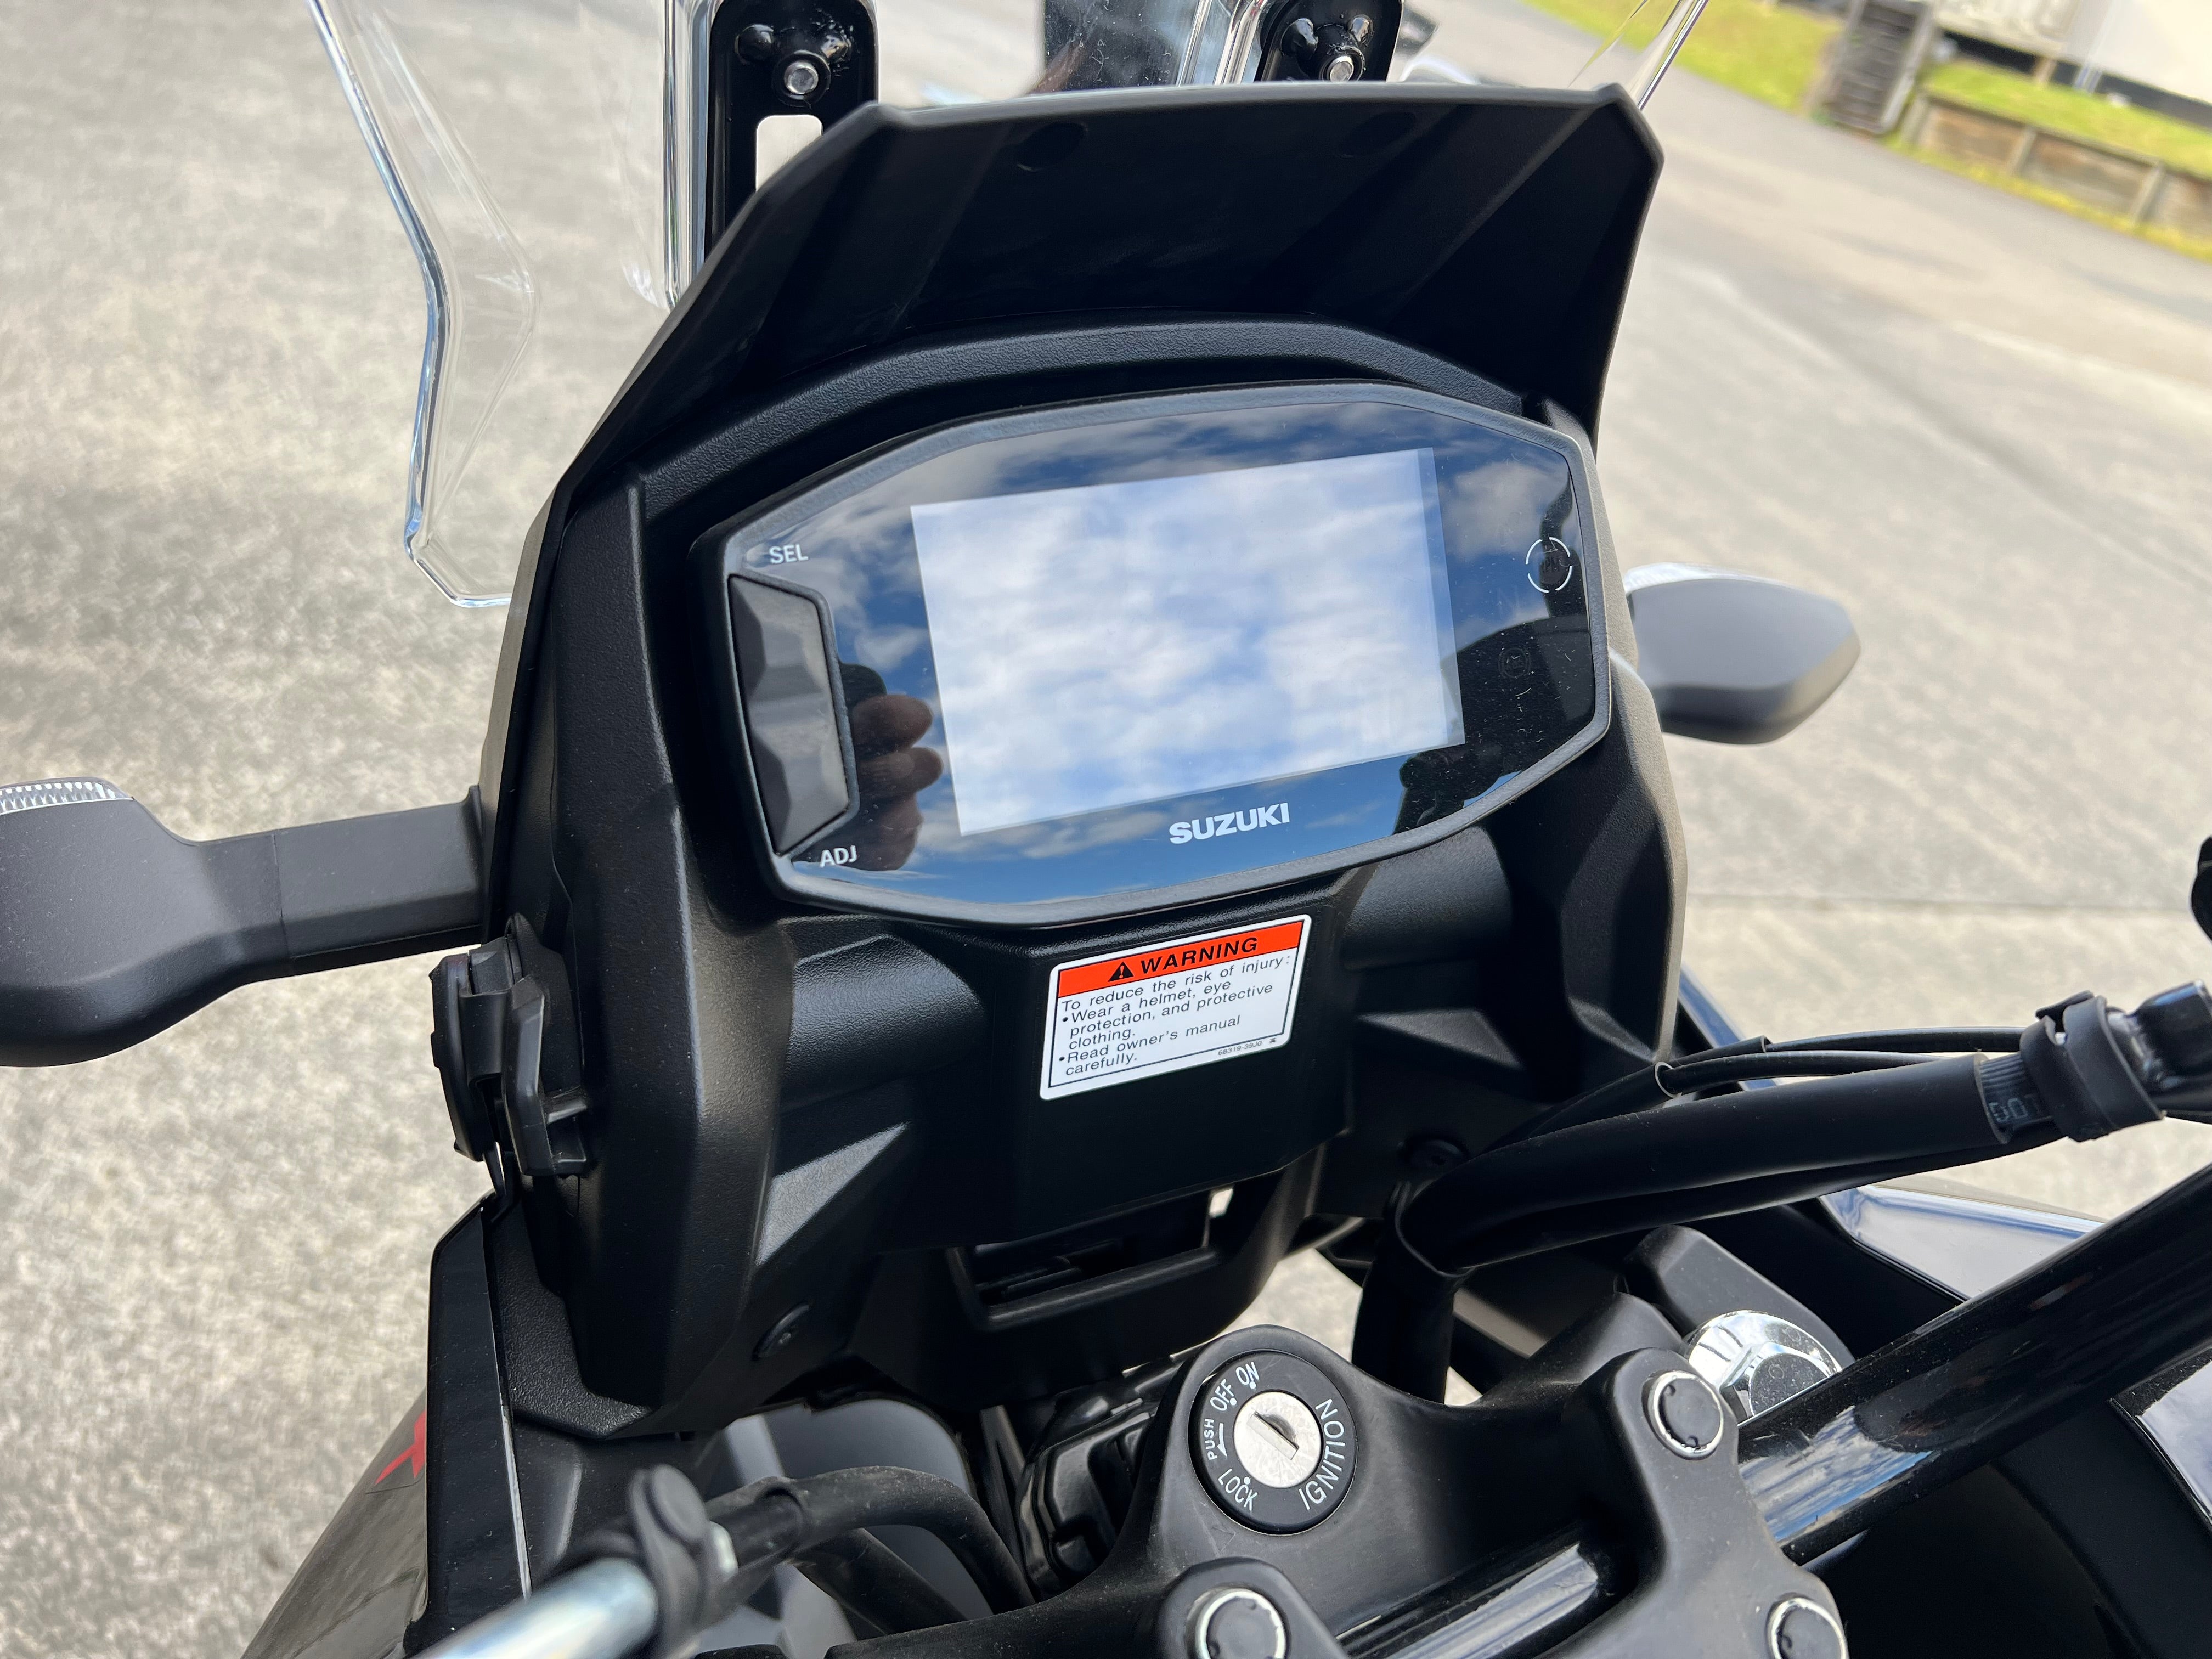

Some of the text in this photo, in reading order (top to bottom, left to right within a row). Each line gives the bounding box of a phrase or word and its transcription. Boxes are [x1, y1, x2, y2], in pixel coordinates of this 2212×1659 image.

[769, 544, 808, 564] SEL
[1169, 802, 1290, 844] SUZUKI
[820, 845, 857, 867] ADJ
[1141, 938, 1257, 974] WARNING
[1062, 1000, 1080, 1012] To
[1090, 987, 1143, 1006] reduce
[1153, 979, 1176, 992] the
[1185, 969, 1211, 986] risk
[1220, 964, 1234, 978] of
[1072, 981, 1231, 1023] Wear a helmet, eye
[1070, 984, 1273, 1039] protection, and protective
[1068, 1015, 1240, 1063] Read owner's manual
[1069, 1029, 1135, 1051] clothing.
[1066, 1052, 1137, 1076] carefully.
[1235, 1362, 1260, 1385] ON
[1210, 1379, 1234, 1411] OFF
[1204, 1418, 1218, 1460] PUSH
[1299, 1399, 1345, 1510] IGNITION
[1218, 1469, 1259, 1511] LOCK
